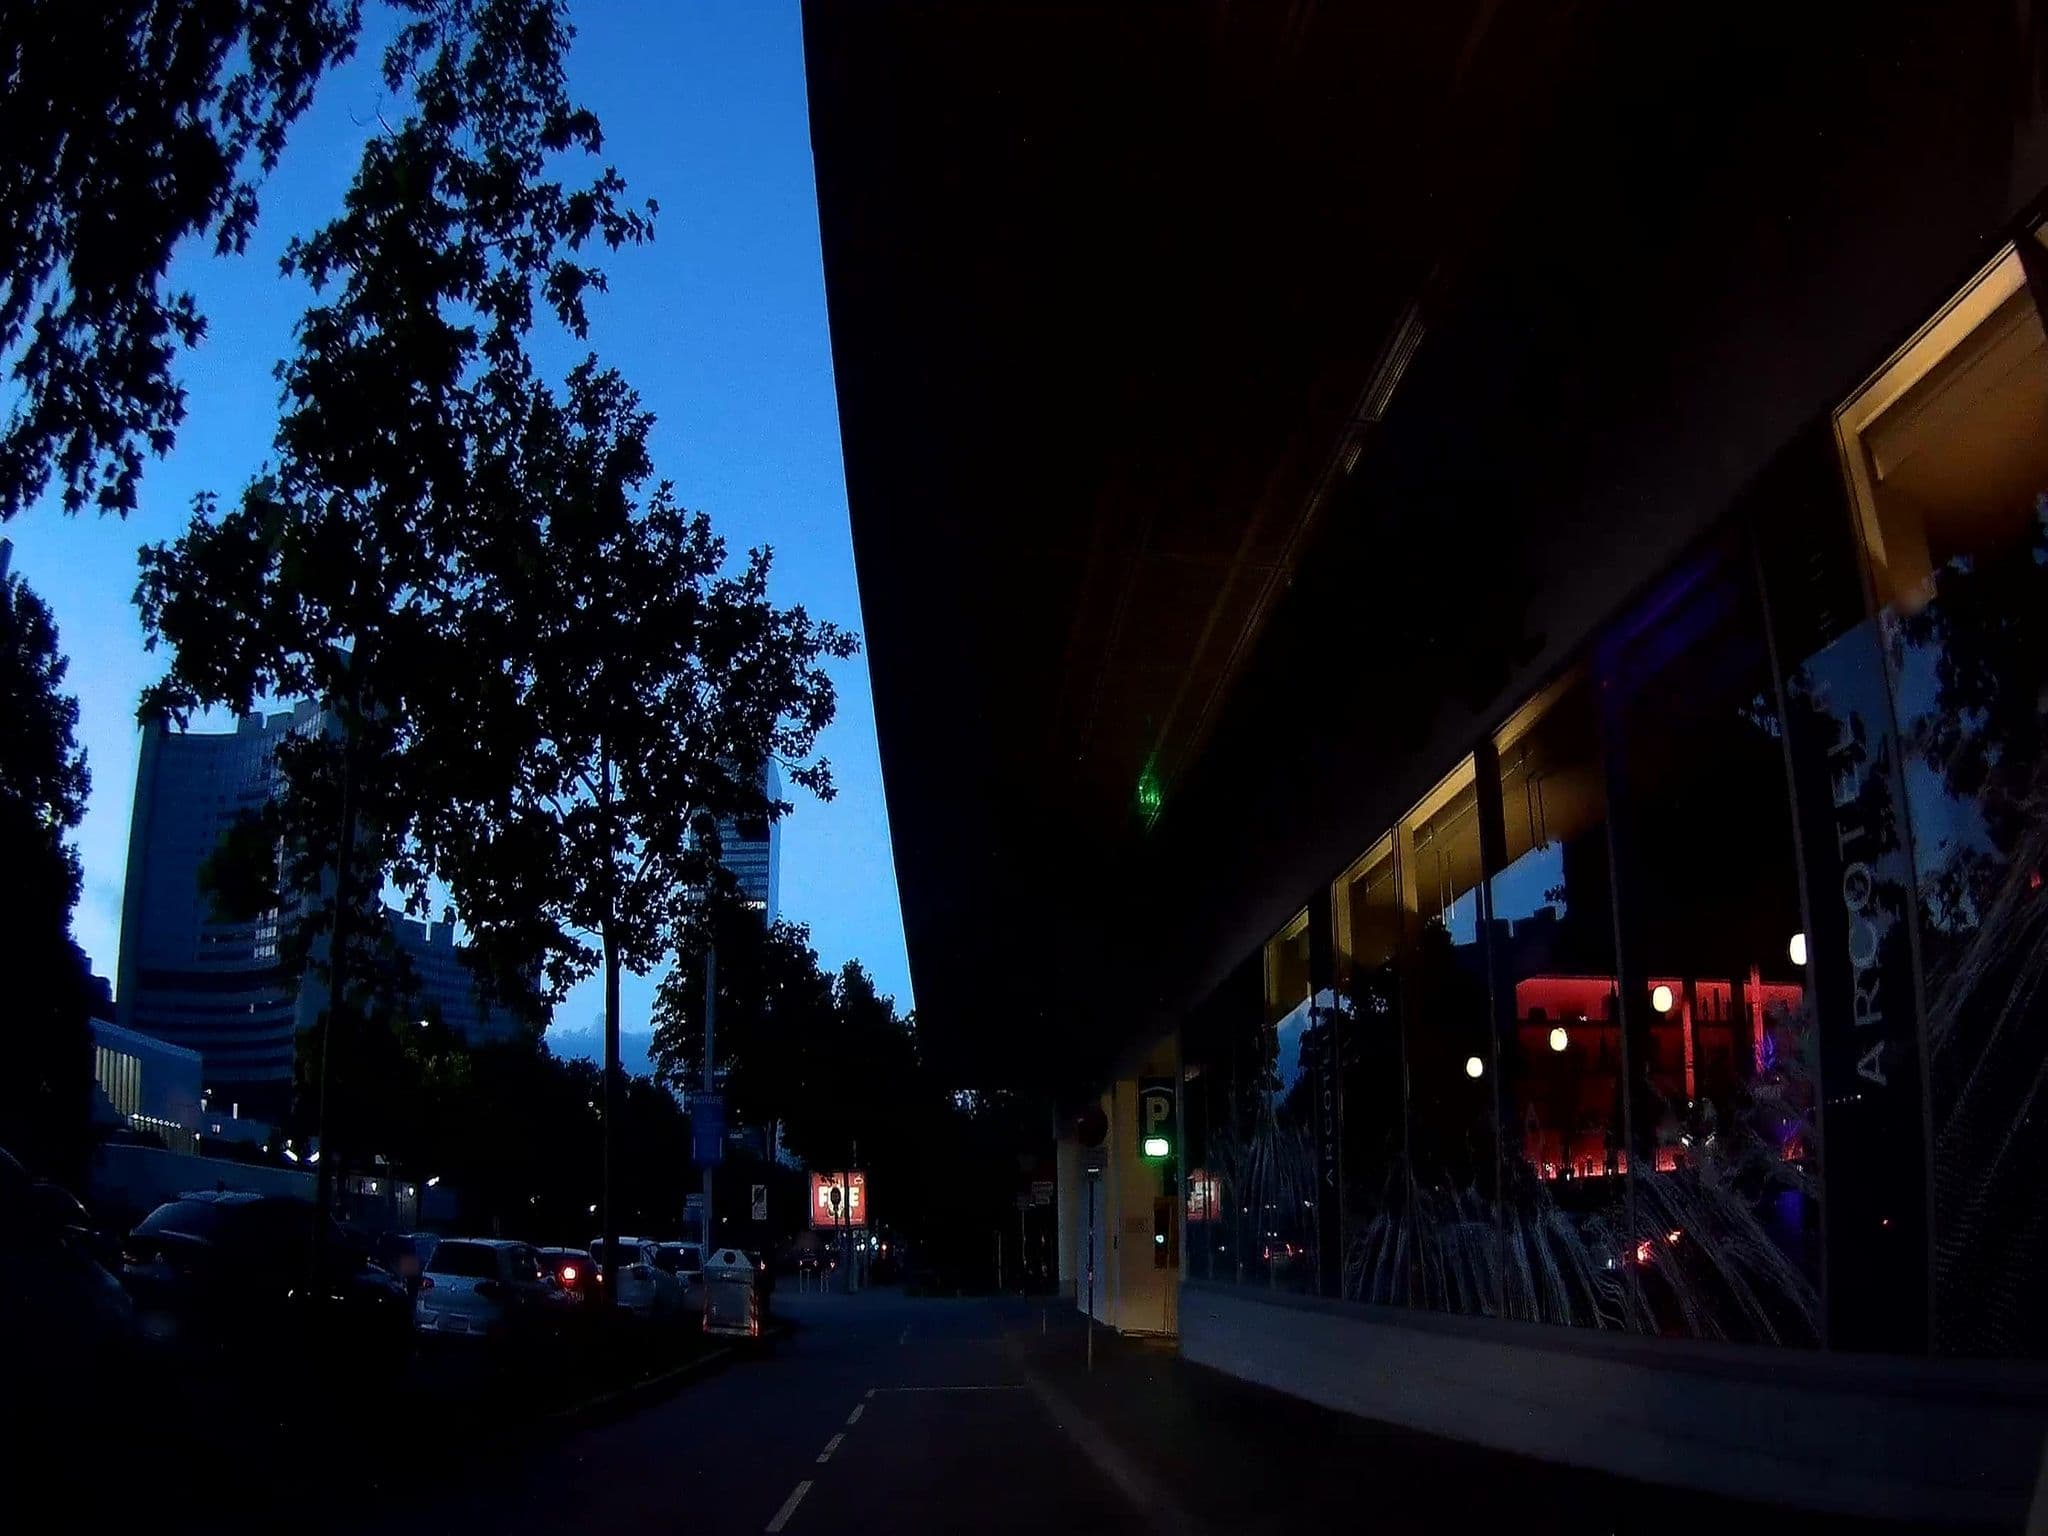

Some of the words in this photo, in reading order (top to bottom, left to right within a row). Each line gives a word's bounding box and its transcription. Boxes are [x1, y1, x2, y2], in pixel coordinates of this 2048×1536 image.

[1827, 709, 1888, 1087] ARCOTEL
[1146, 1095, 1170, 1135] P
[818, 1186, 860, 1208] FE
